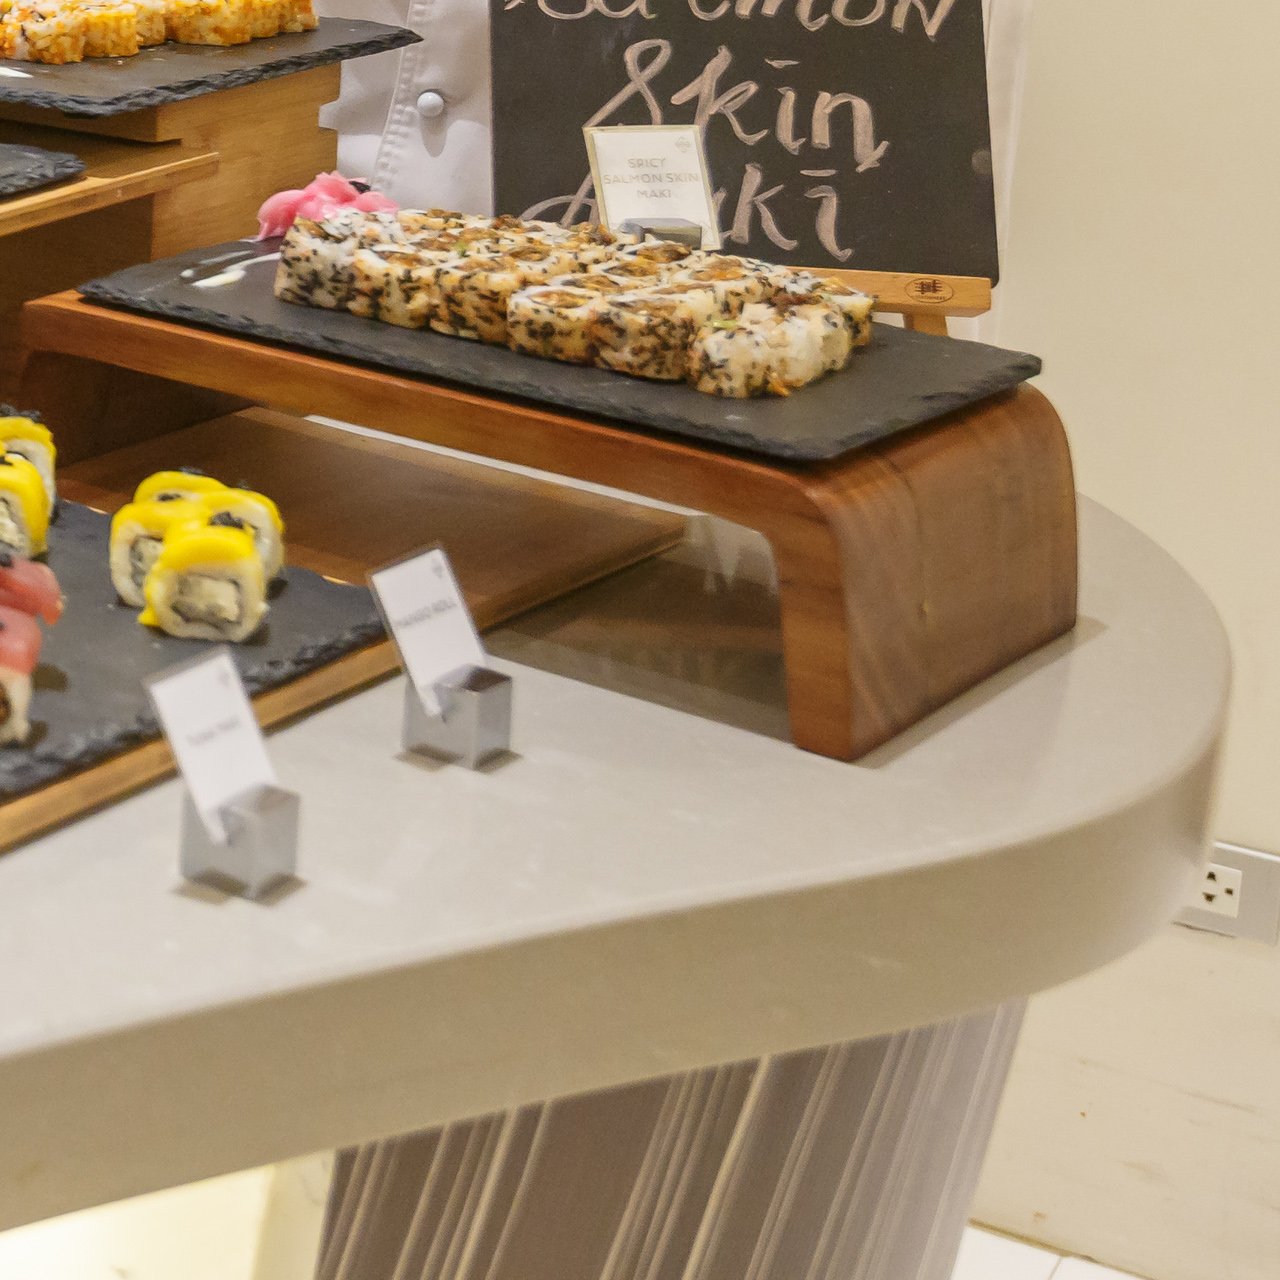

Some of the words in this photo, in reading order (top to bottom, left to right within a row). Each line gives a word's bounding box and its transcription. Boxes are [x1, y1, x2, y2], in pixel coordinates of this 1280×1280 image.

[627, 157, 666, 169] SPICY
[603, 172, 663, 185] SALMON
[665, 171, 699, 184] SKIN
[637, 188, 672, 199] MAKI
